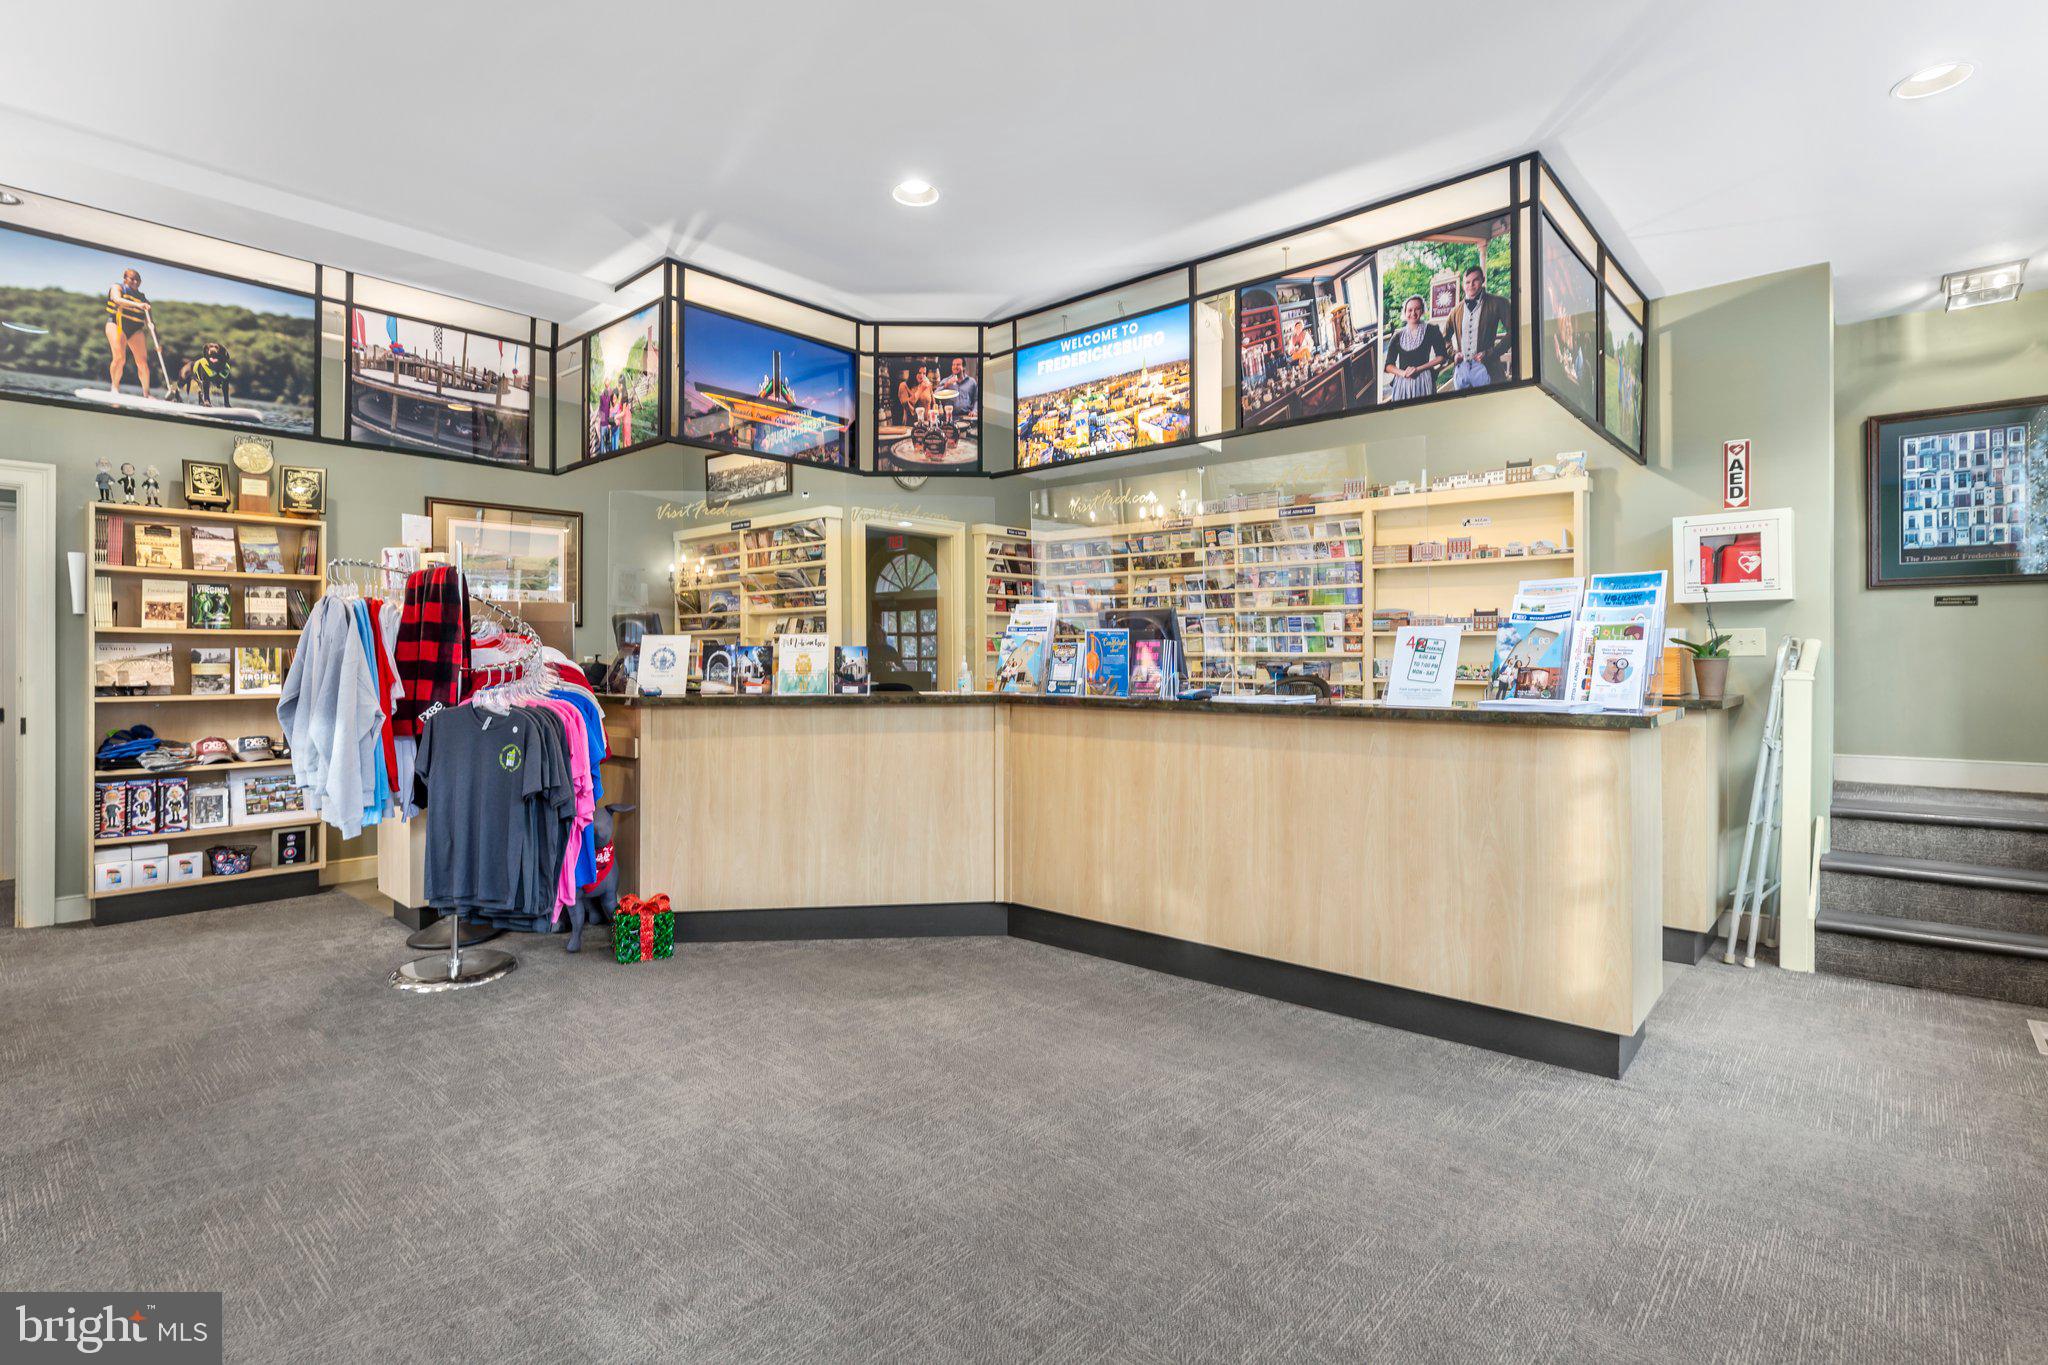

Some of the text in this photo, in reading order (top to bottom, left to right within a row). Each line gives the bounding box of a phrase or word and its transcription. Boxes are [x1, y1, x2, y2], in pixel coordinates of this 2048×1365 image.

[1060, 322, 1139, 353] WELCOME TO
[1037, 331, 1165, 376] FREDERICKSBURG
[1728, 458, 1745, 499] AED
[1905, 555, 1920, 563] The
[1923, 554, 1948, 562] Doors
[1950, 552, 1959, 560] of
[197, 586, 230, 595] VIRGINIA
[240, 672, 277, 681] VIRGINIA
[418, 701, 443, 722] FXBG
[245, 736, 268, 748] FXBG
